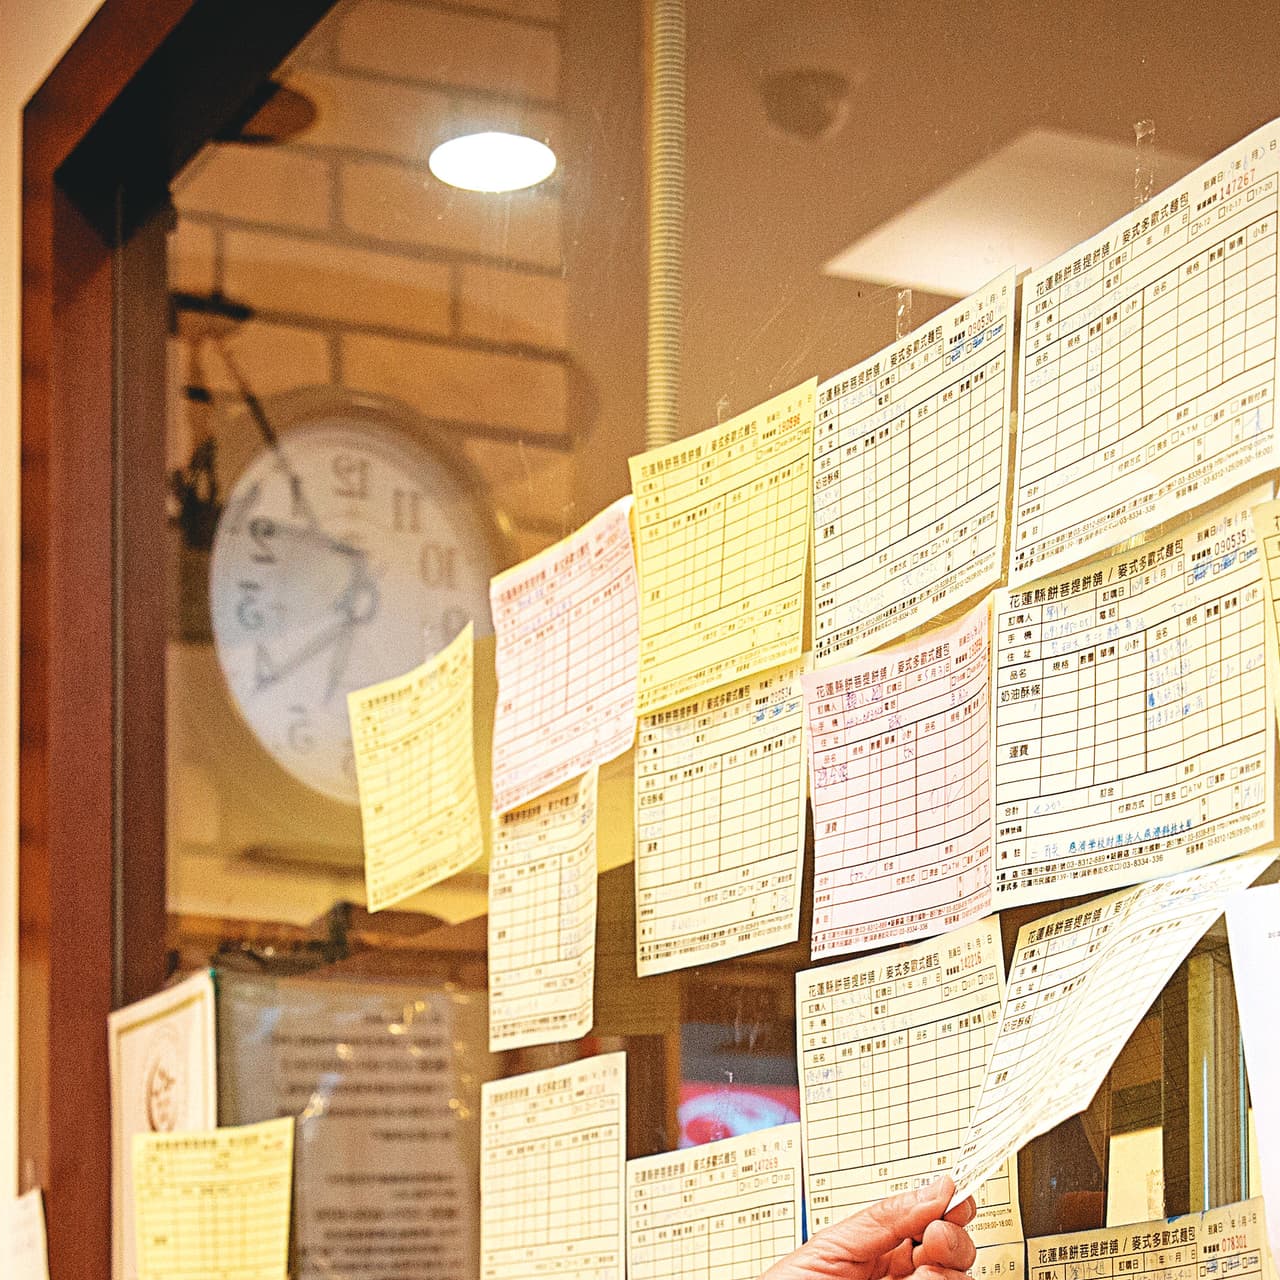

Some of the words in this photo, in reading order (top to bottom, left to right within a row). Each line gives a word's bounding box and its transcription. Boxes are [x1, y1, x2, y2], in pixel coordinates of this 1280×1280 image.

[1220, 169, 1255, 201] 147267
[1214, 532, 1247, 555] 090535
[1008, 613, 1032, 625] 訂購人
[1010, 669, 1026, 679] 品名
[1222, 1235, 1248, 1252] 078301
[1039, 1270, 1058, 1280] 訂購人
